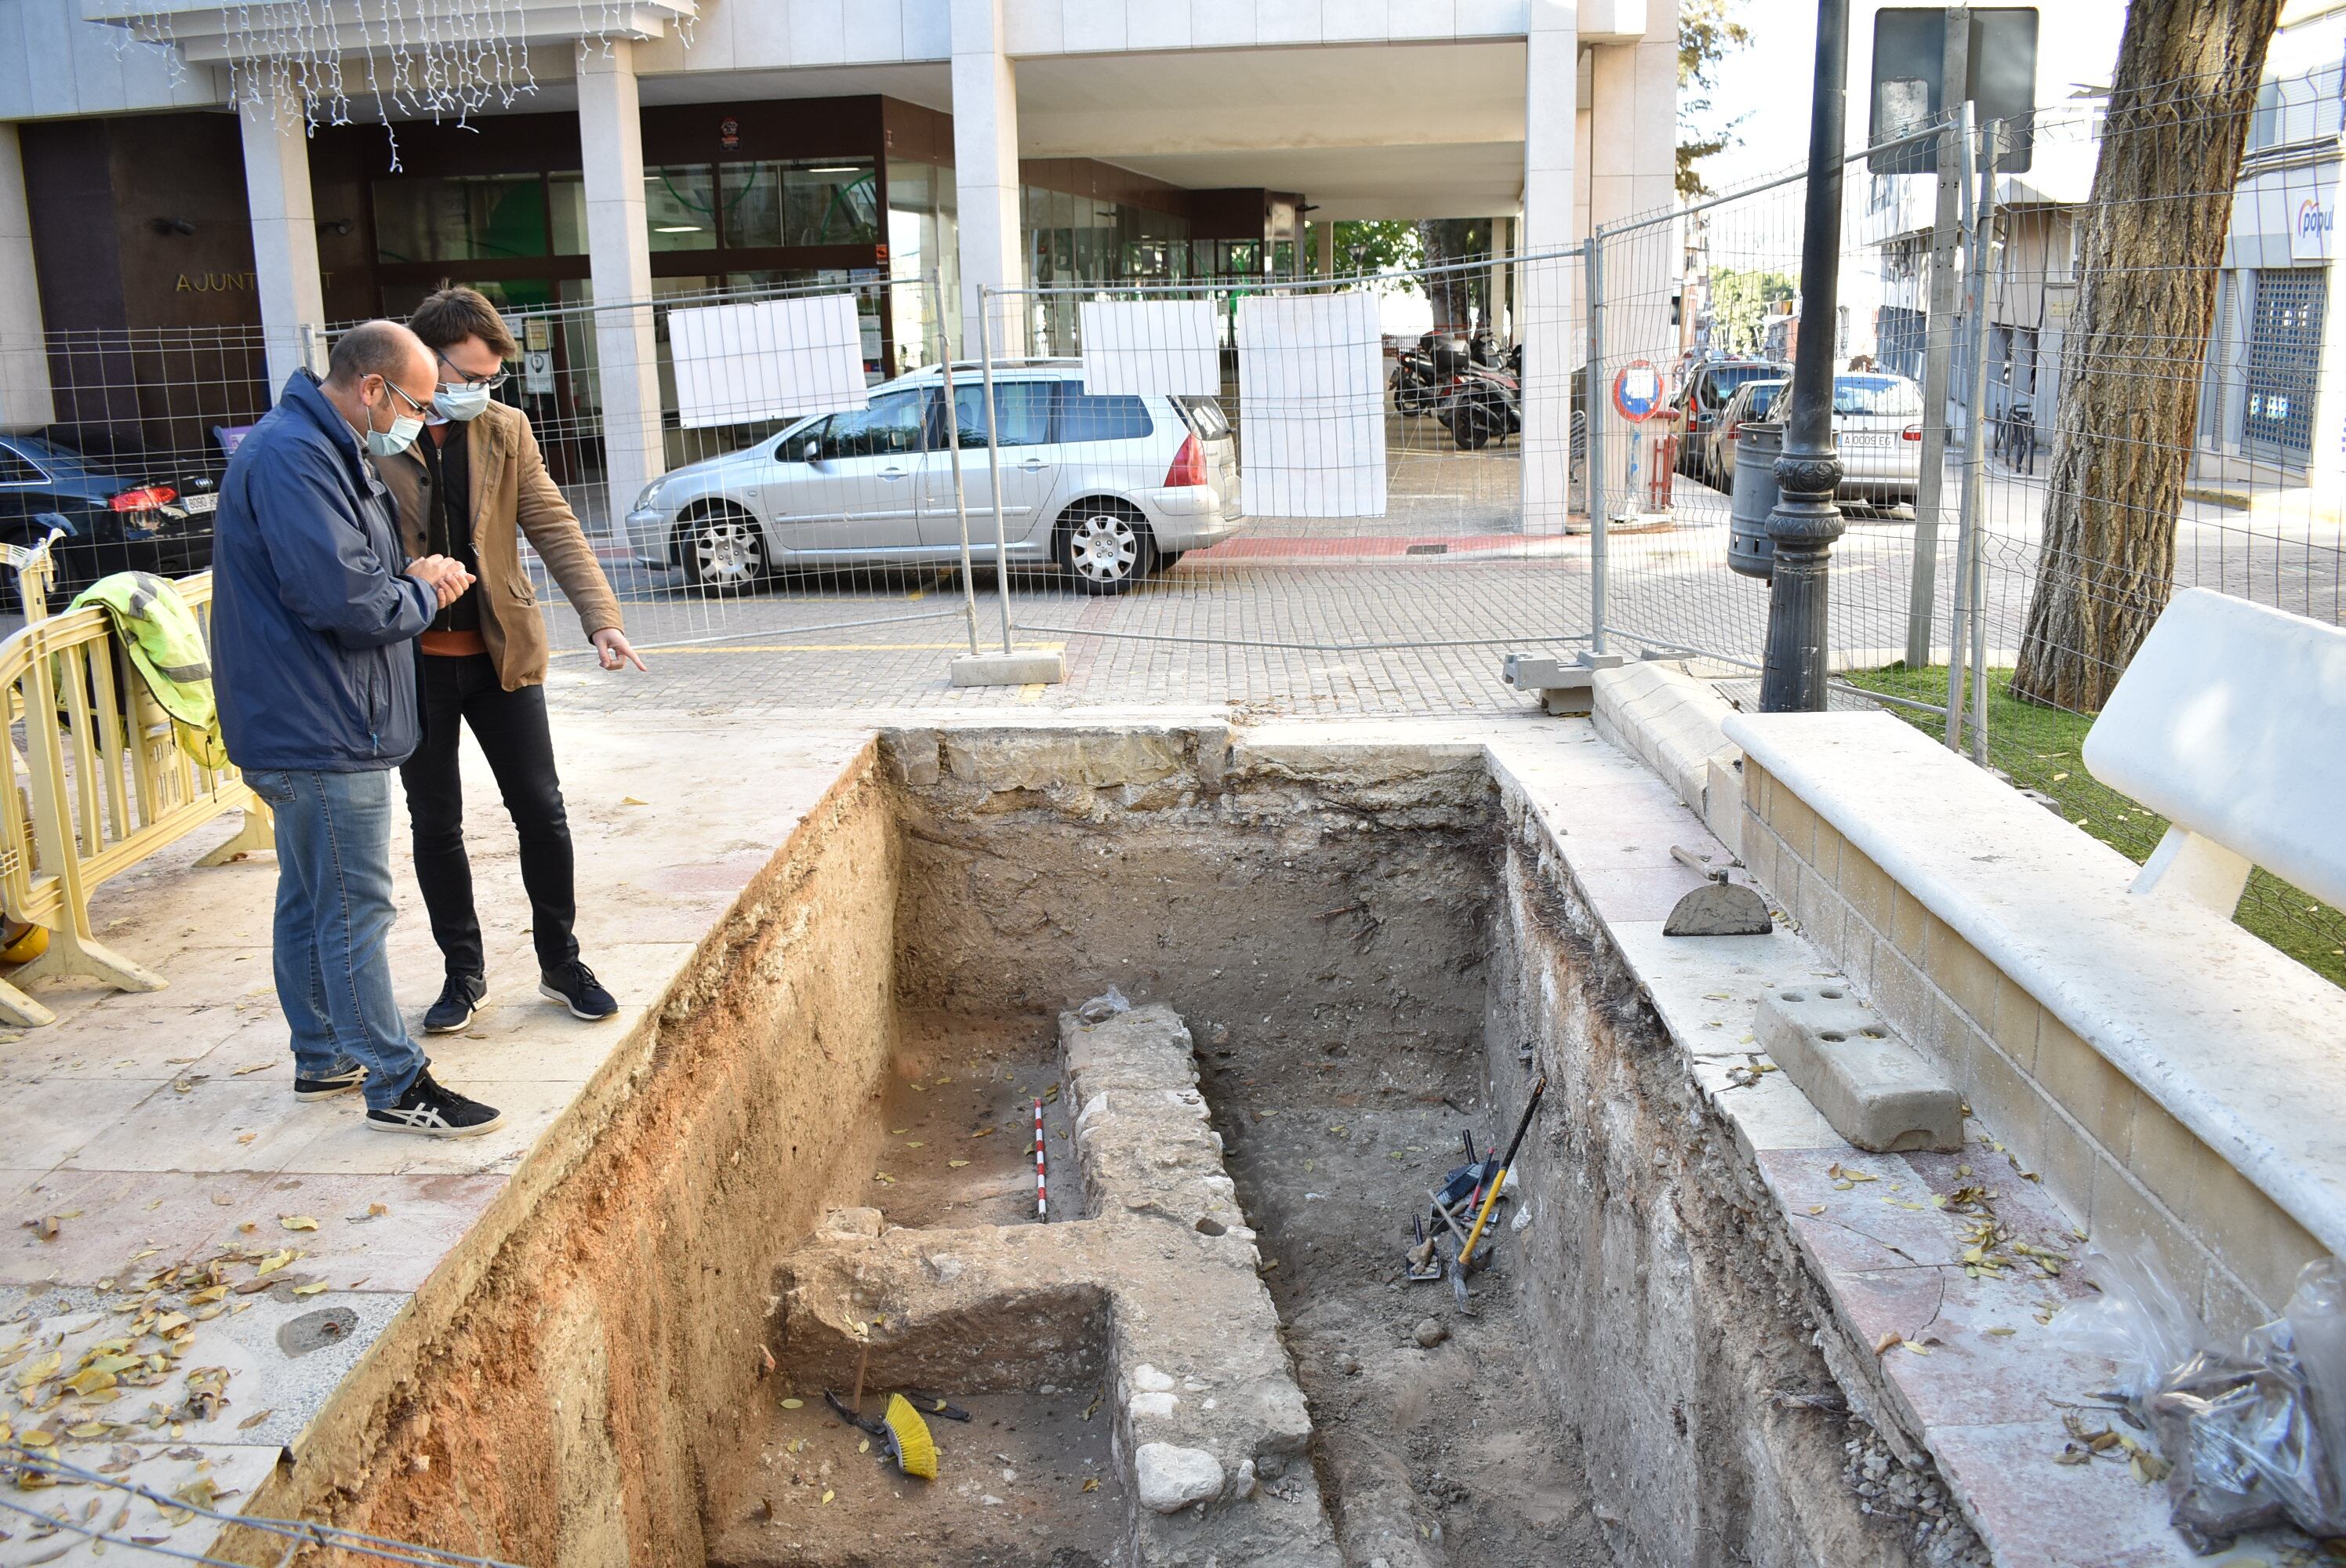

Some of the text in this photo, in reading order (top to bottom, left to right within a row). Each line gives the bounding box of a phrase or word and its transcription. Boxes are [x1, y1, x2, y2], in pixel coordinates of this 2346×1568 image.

[2302, 204, 2335, 238] popul
[176, 273, 334, 292] AJUNTT
[1879, 437, 1890, 445] EG
